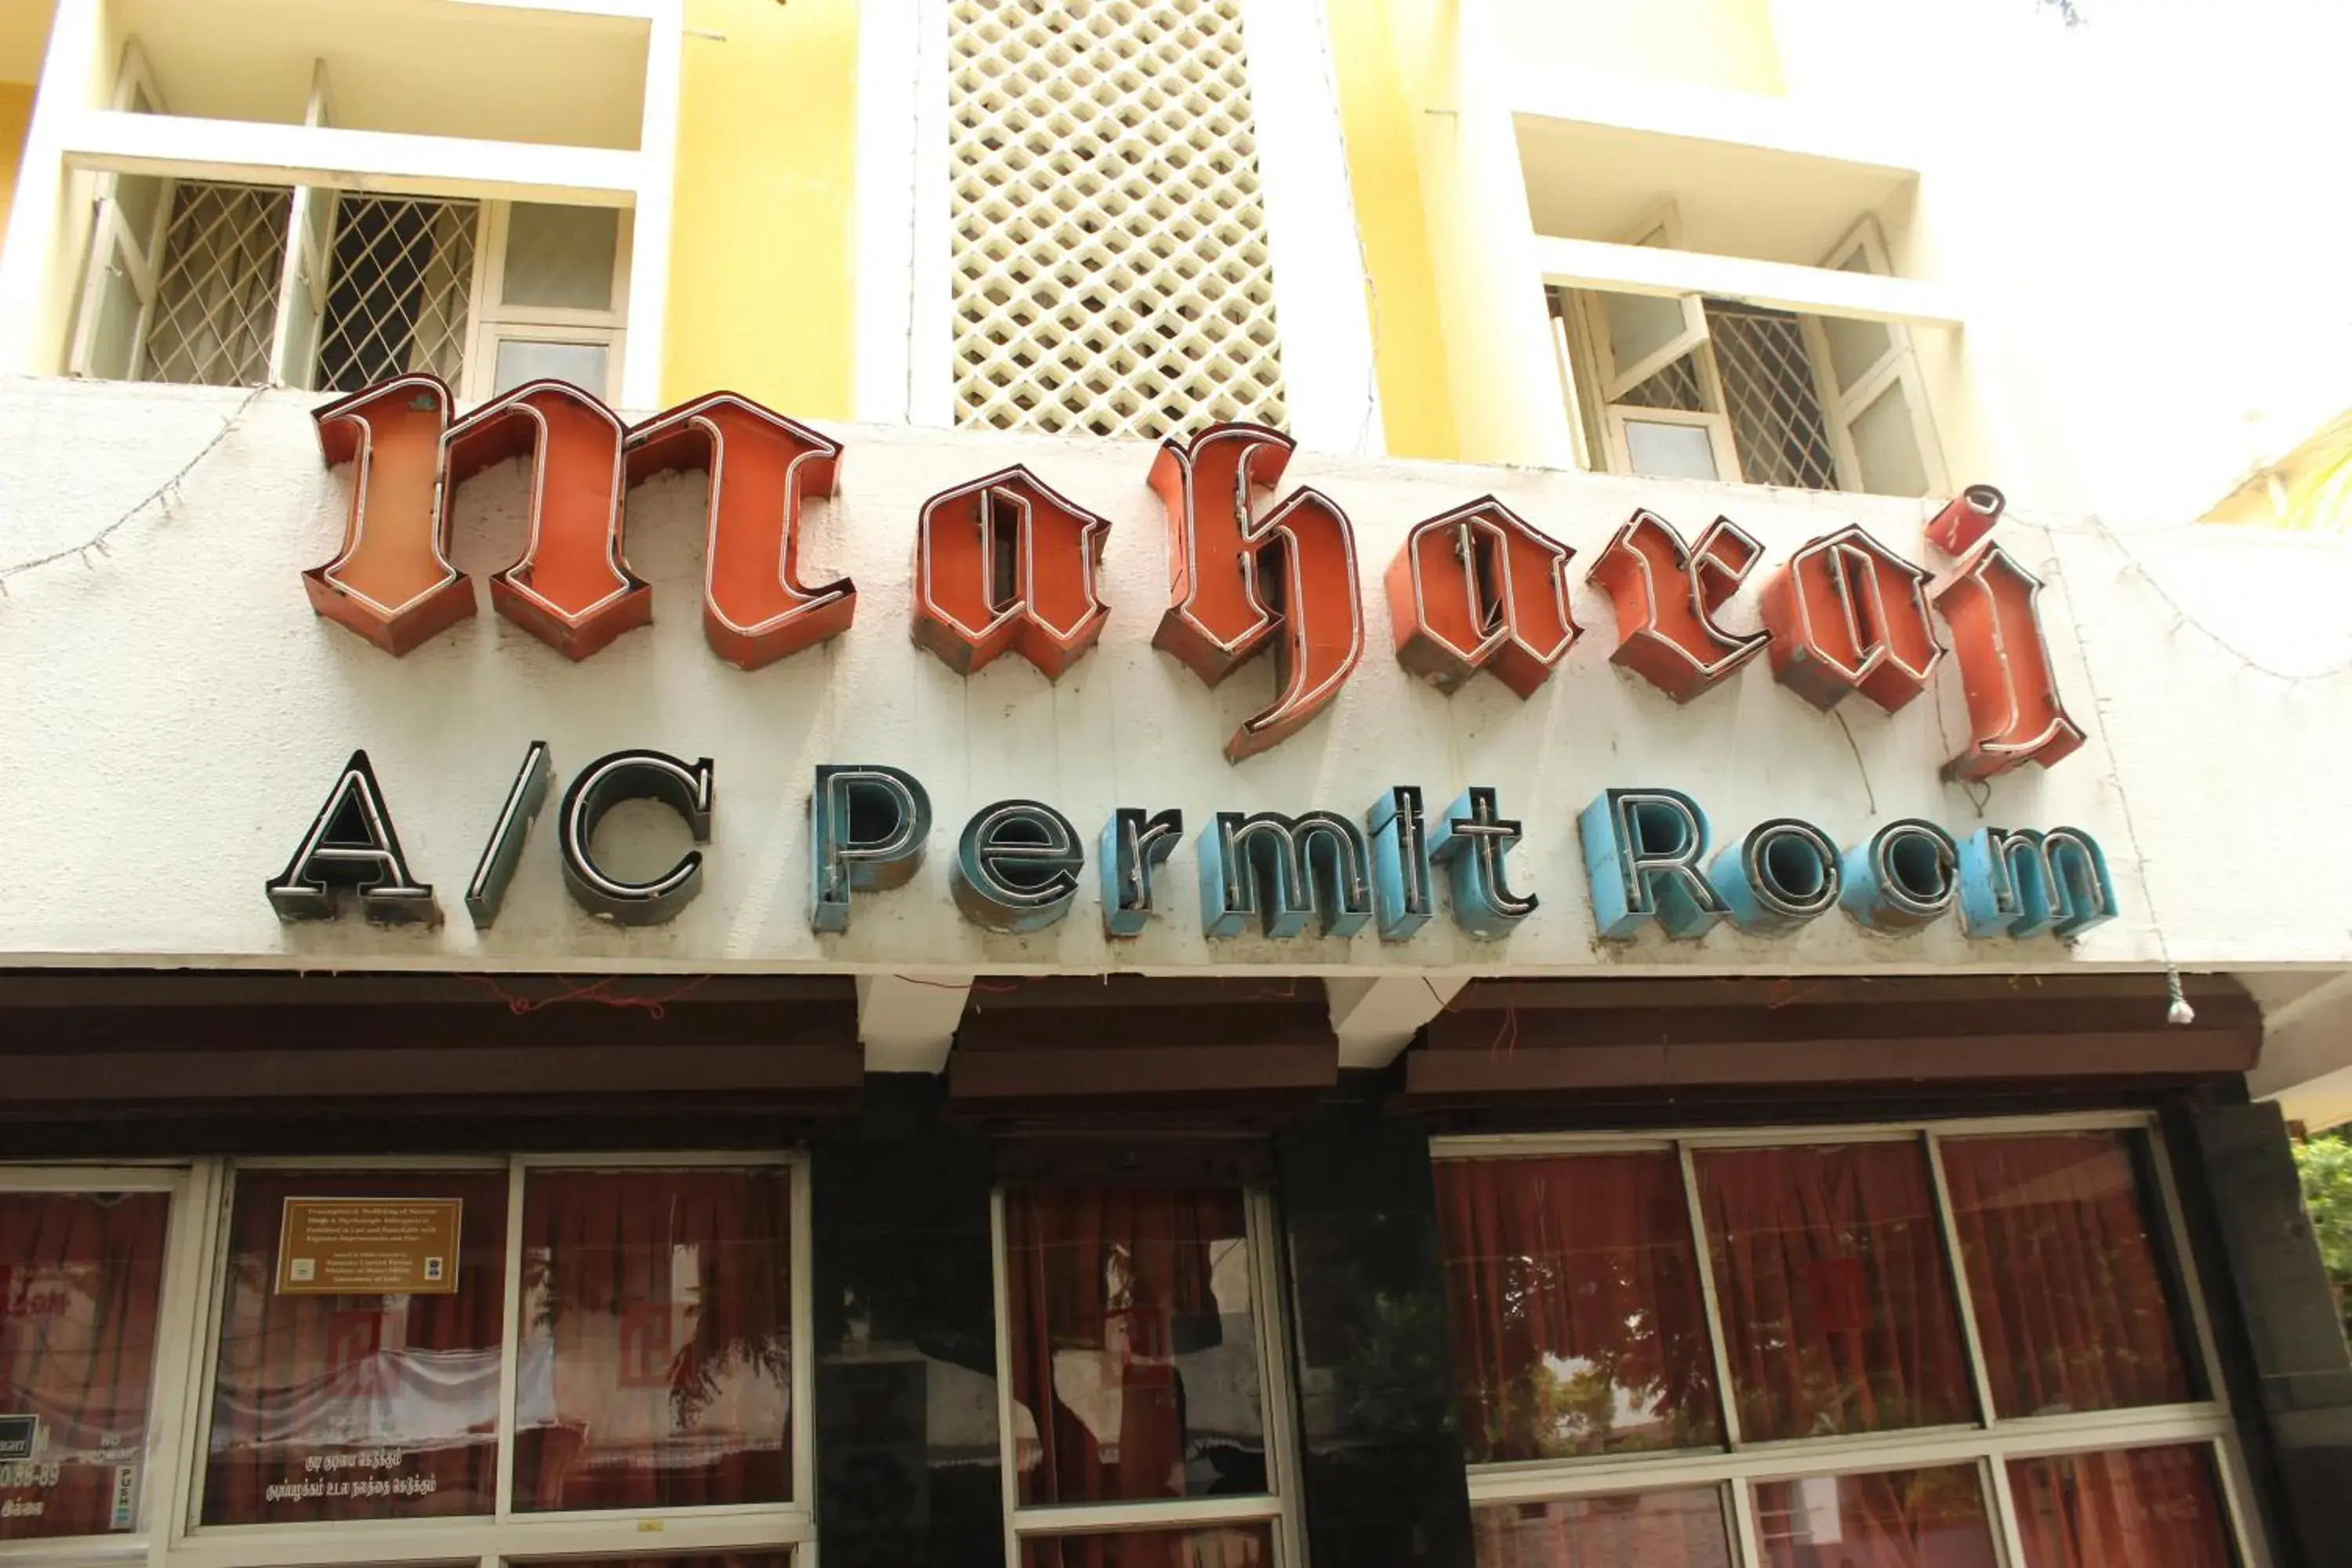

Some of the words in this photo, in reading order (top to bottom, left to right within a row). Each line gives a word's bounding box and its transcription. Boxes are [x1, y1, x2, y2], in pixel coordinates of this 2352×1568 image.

[266, 741, 713, 928] A/C
[810, 764, 1539, 942] Permit
[1578, 787, 2118, 944] Room
[120, 1468, 132, 1506] PUSH
